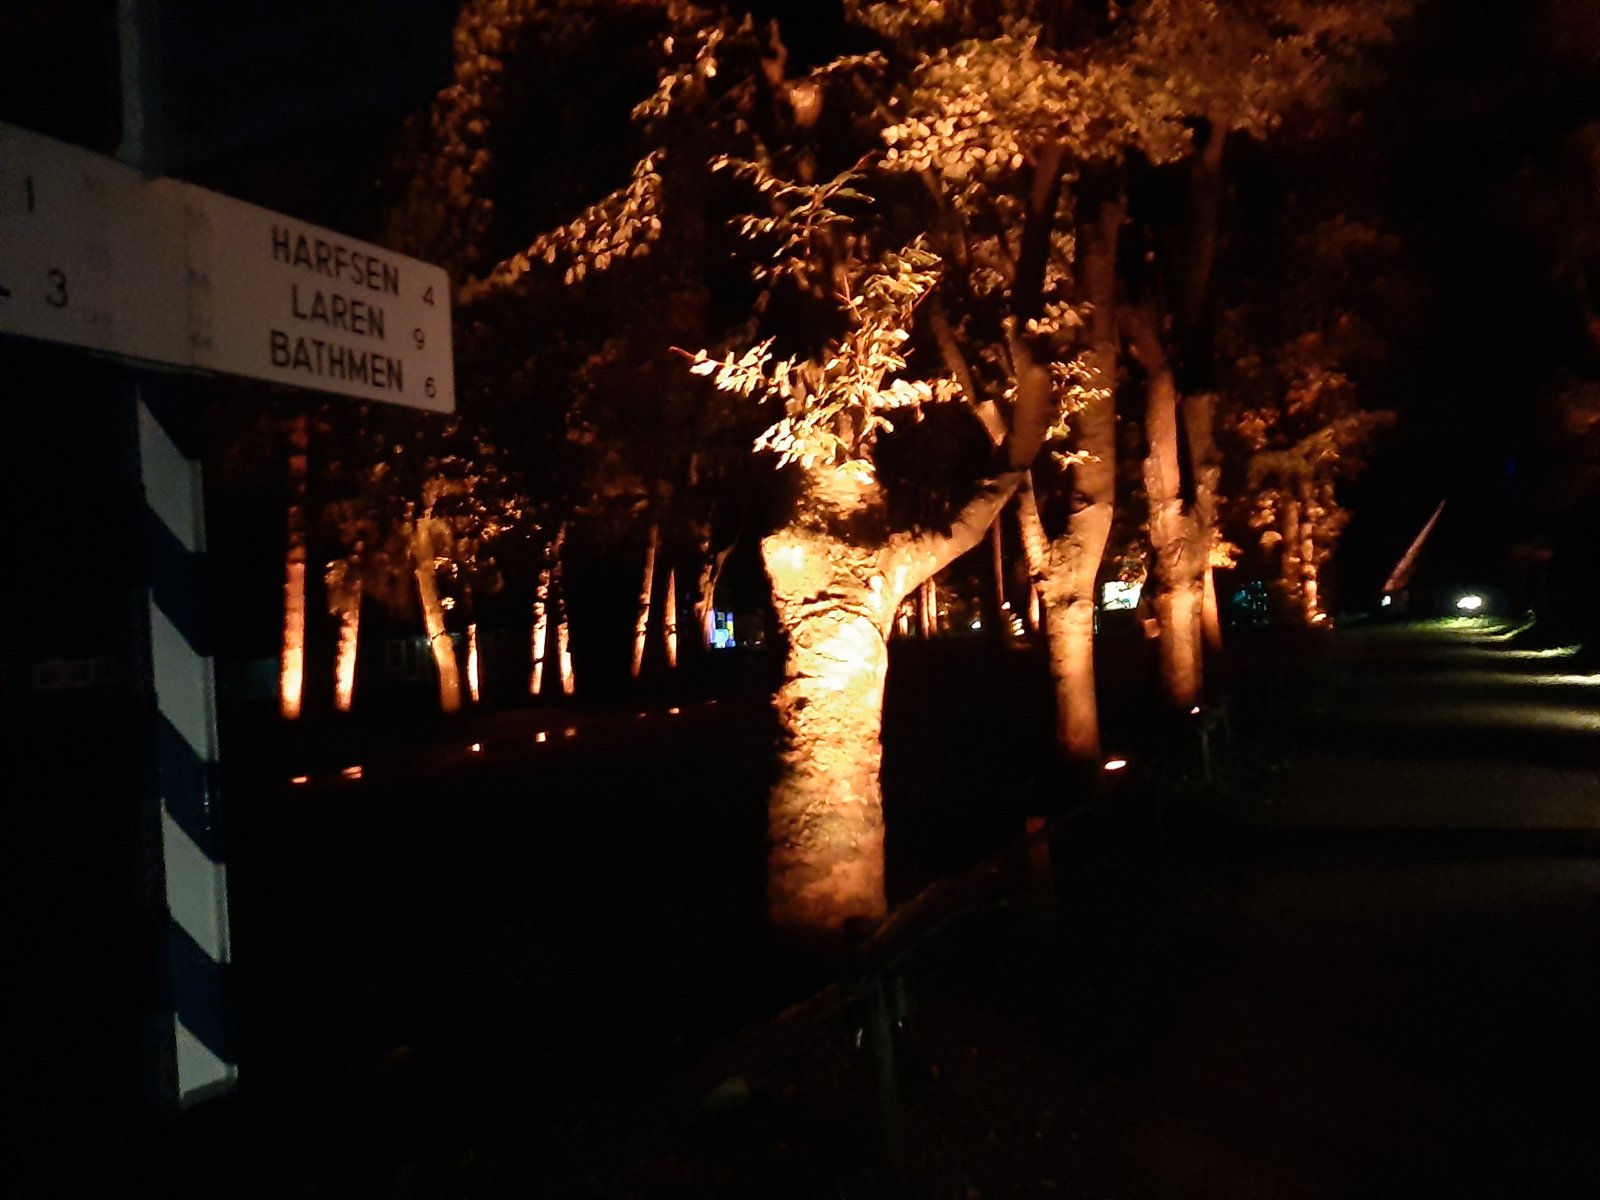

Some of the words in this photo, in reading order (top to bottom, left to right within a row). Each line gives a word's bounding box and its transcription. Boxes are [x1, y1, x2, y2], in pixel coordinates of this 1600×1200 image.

[47, 268, 67, 308] 3
[272, 225, 398, 295] HARFSEN
[423, 287, 435, 306] 4
[291, 284, 384, 339] LAREN
[413, 327, 425, 350] 9
[270, 329, 403, 392] BATHMEN
[425, 376, 437, 398] 6
